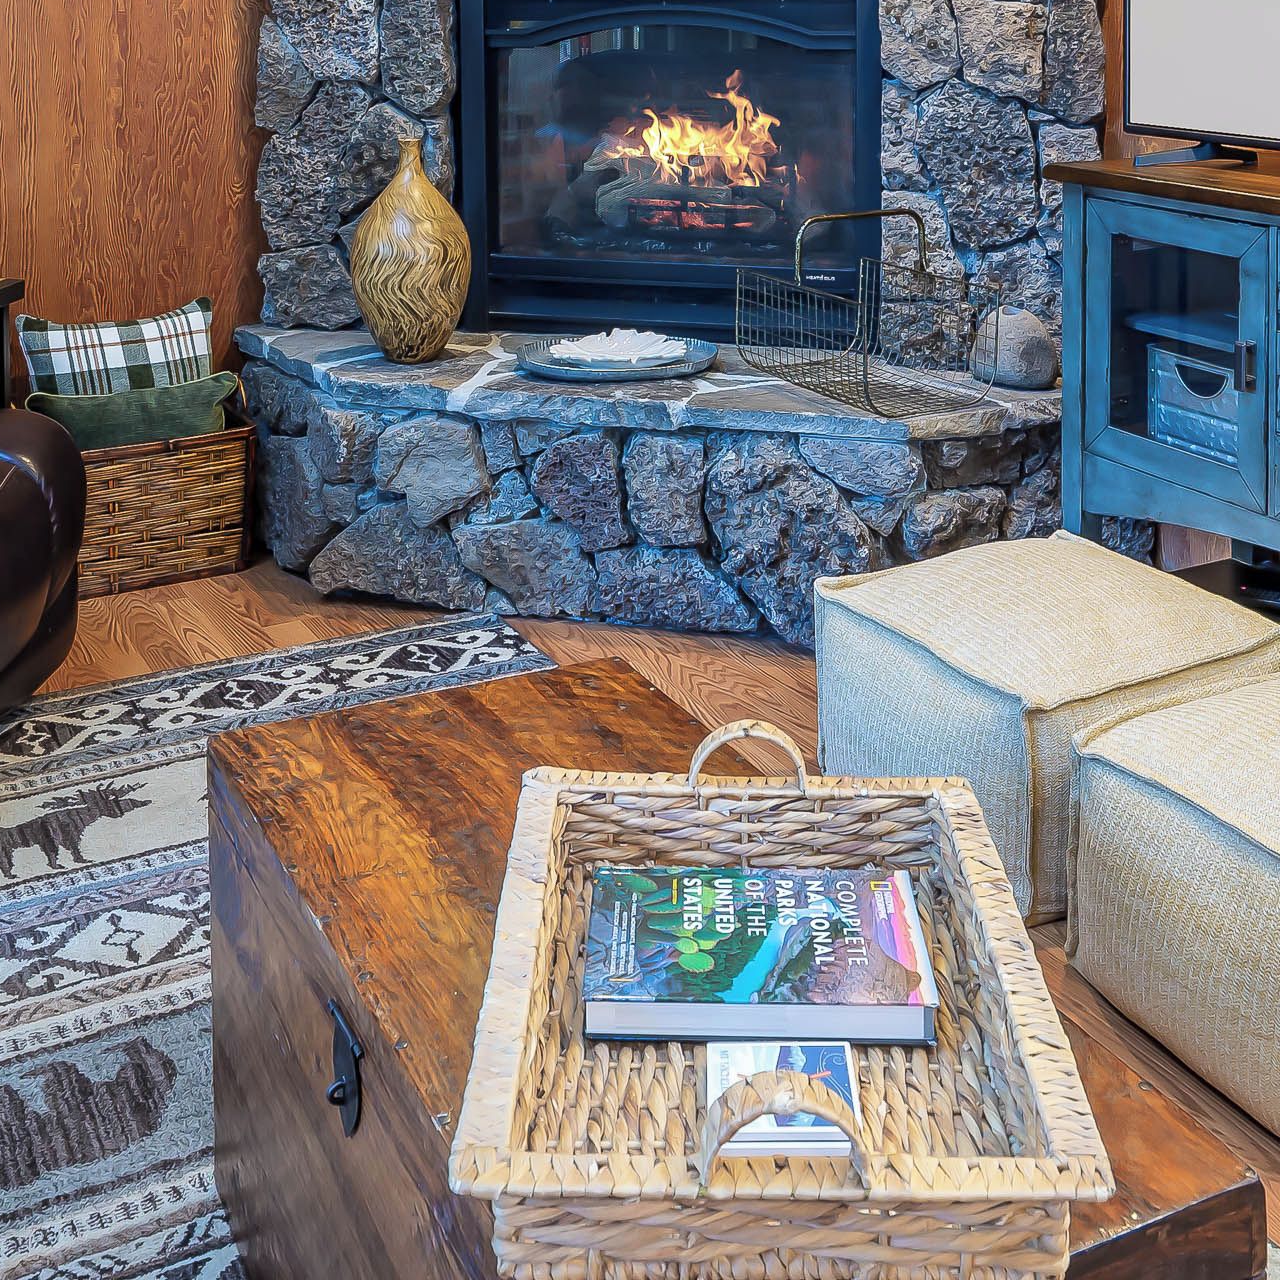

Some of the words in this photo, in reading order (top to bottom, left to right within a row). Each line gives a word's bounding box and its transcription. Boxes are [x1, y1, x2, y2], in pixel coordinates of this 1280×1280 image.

[683, 877, 703, 931] STATES
[714, 878, 735, 935] UNITED
[744, 879, 765, 903] OF
[775, 879, 798, 926] PARKS
[746, 904, 767, 937] THE
[805, 880, 835, 966] NATIONAL
[835, 880, 869, 967] COMPLETE
